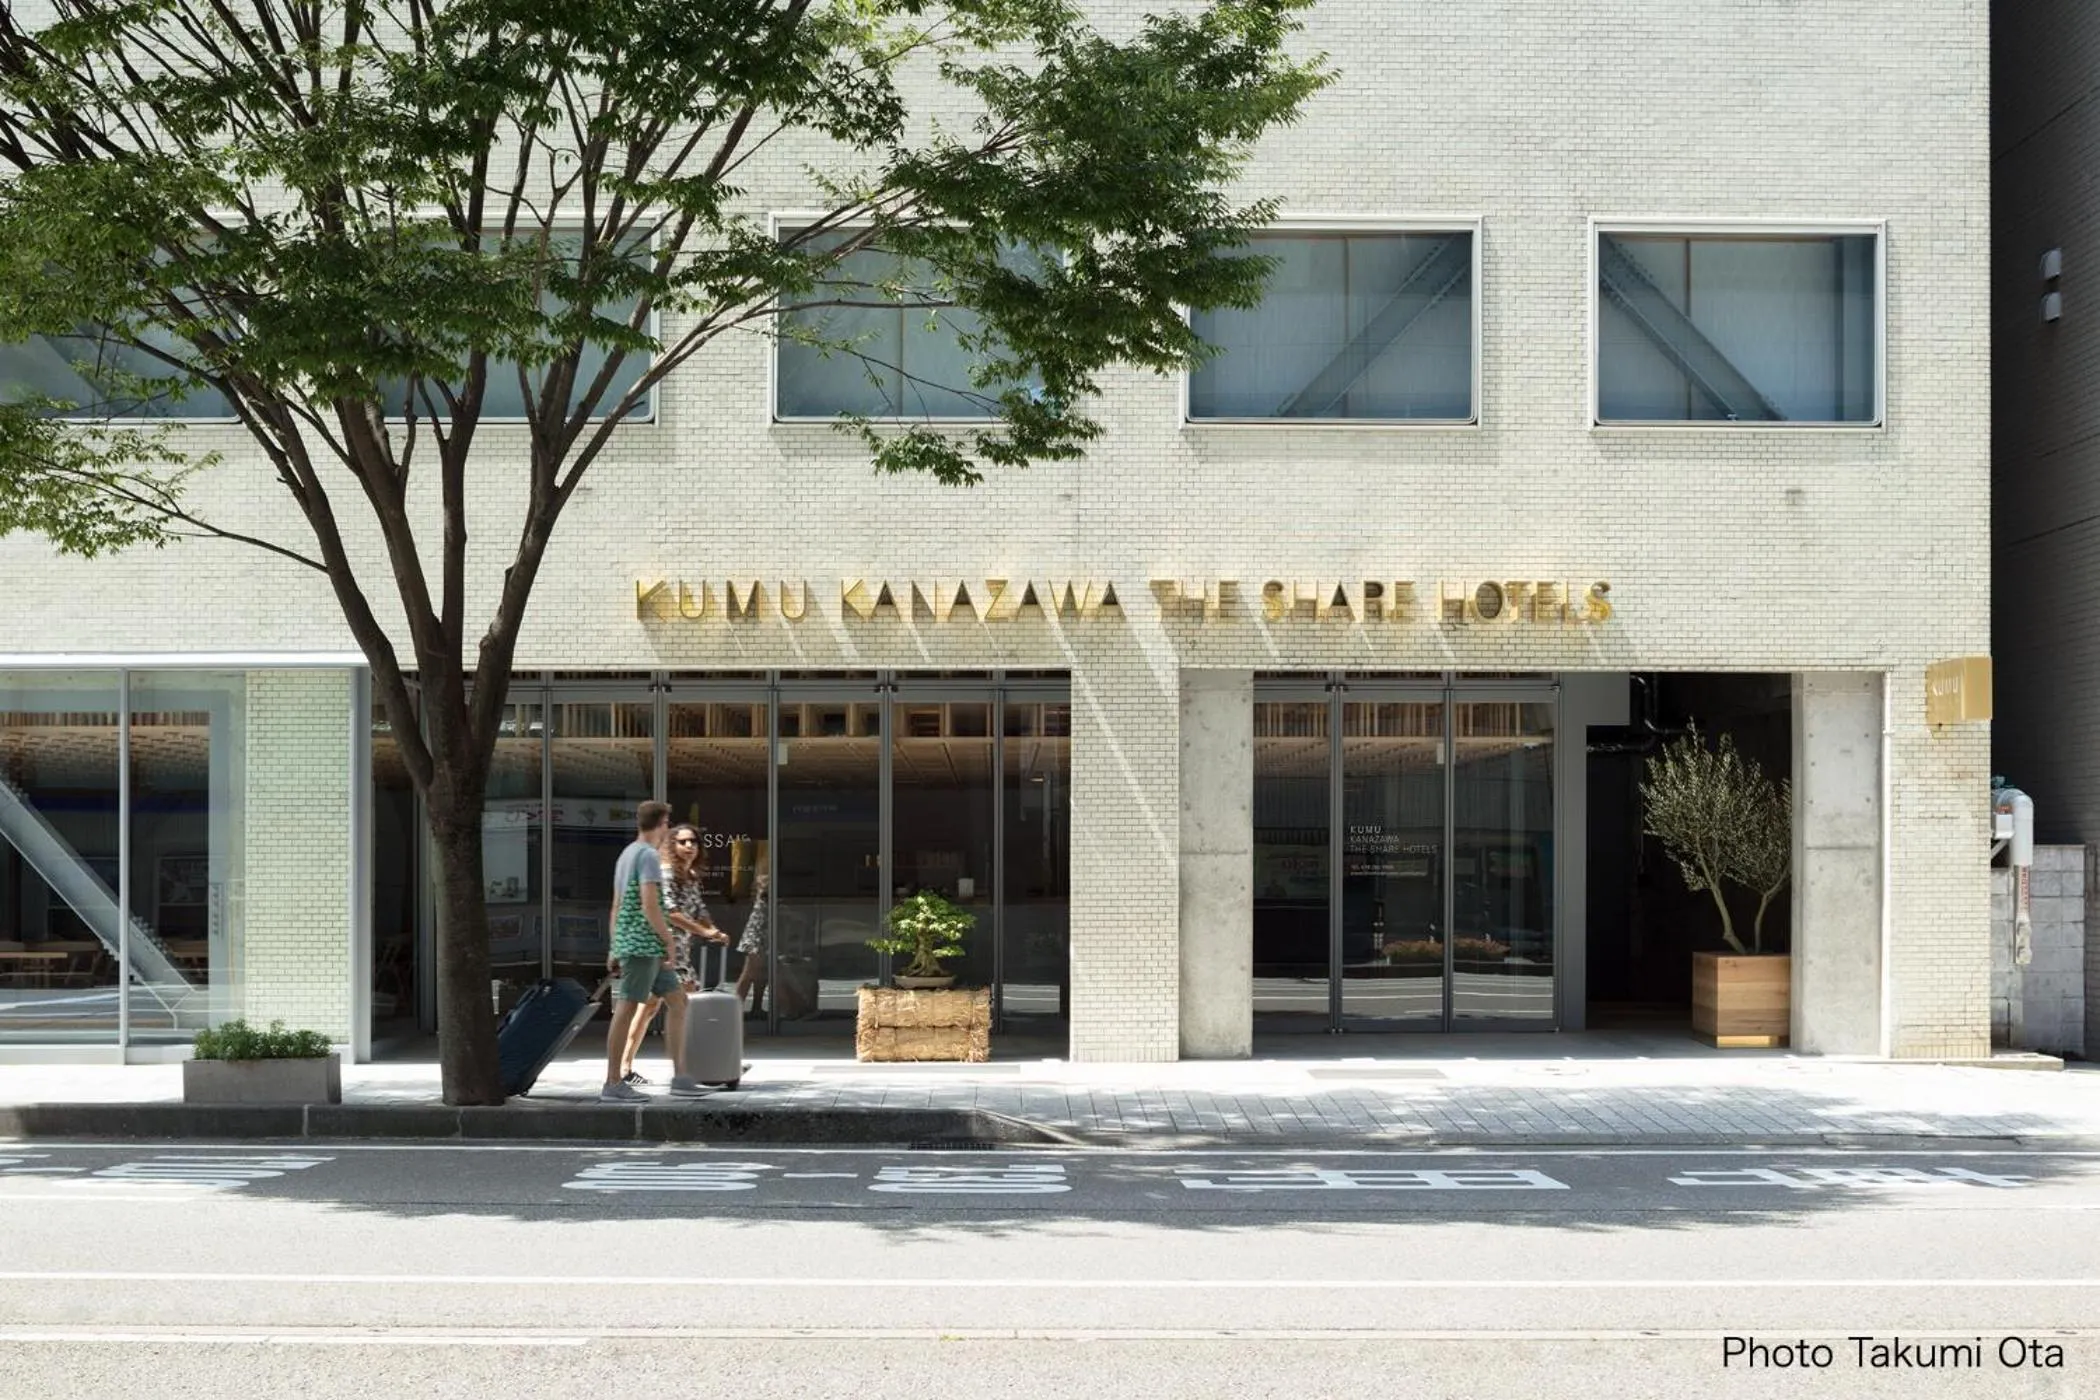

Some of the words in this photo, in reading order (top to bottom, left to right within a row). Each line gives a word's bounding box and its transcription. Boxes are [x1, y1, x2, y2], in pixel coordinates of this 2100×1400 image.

[636, 579, 809, 622] KUMU
[841, 579, 1127, 622] KANAZAWA
[1149, 579, 1239, 622] THE
[1262, 579, 1417, 623] SHARE
[1437, 579, 1613, 624] HOTELS
[1349, 825, 1382, 834] KUMU
[1349, 835, 1400, 843] KANAZAWA
